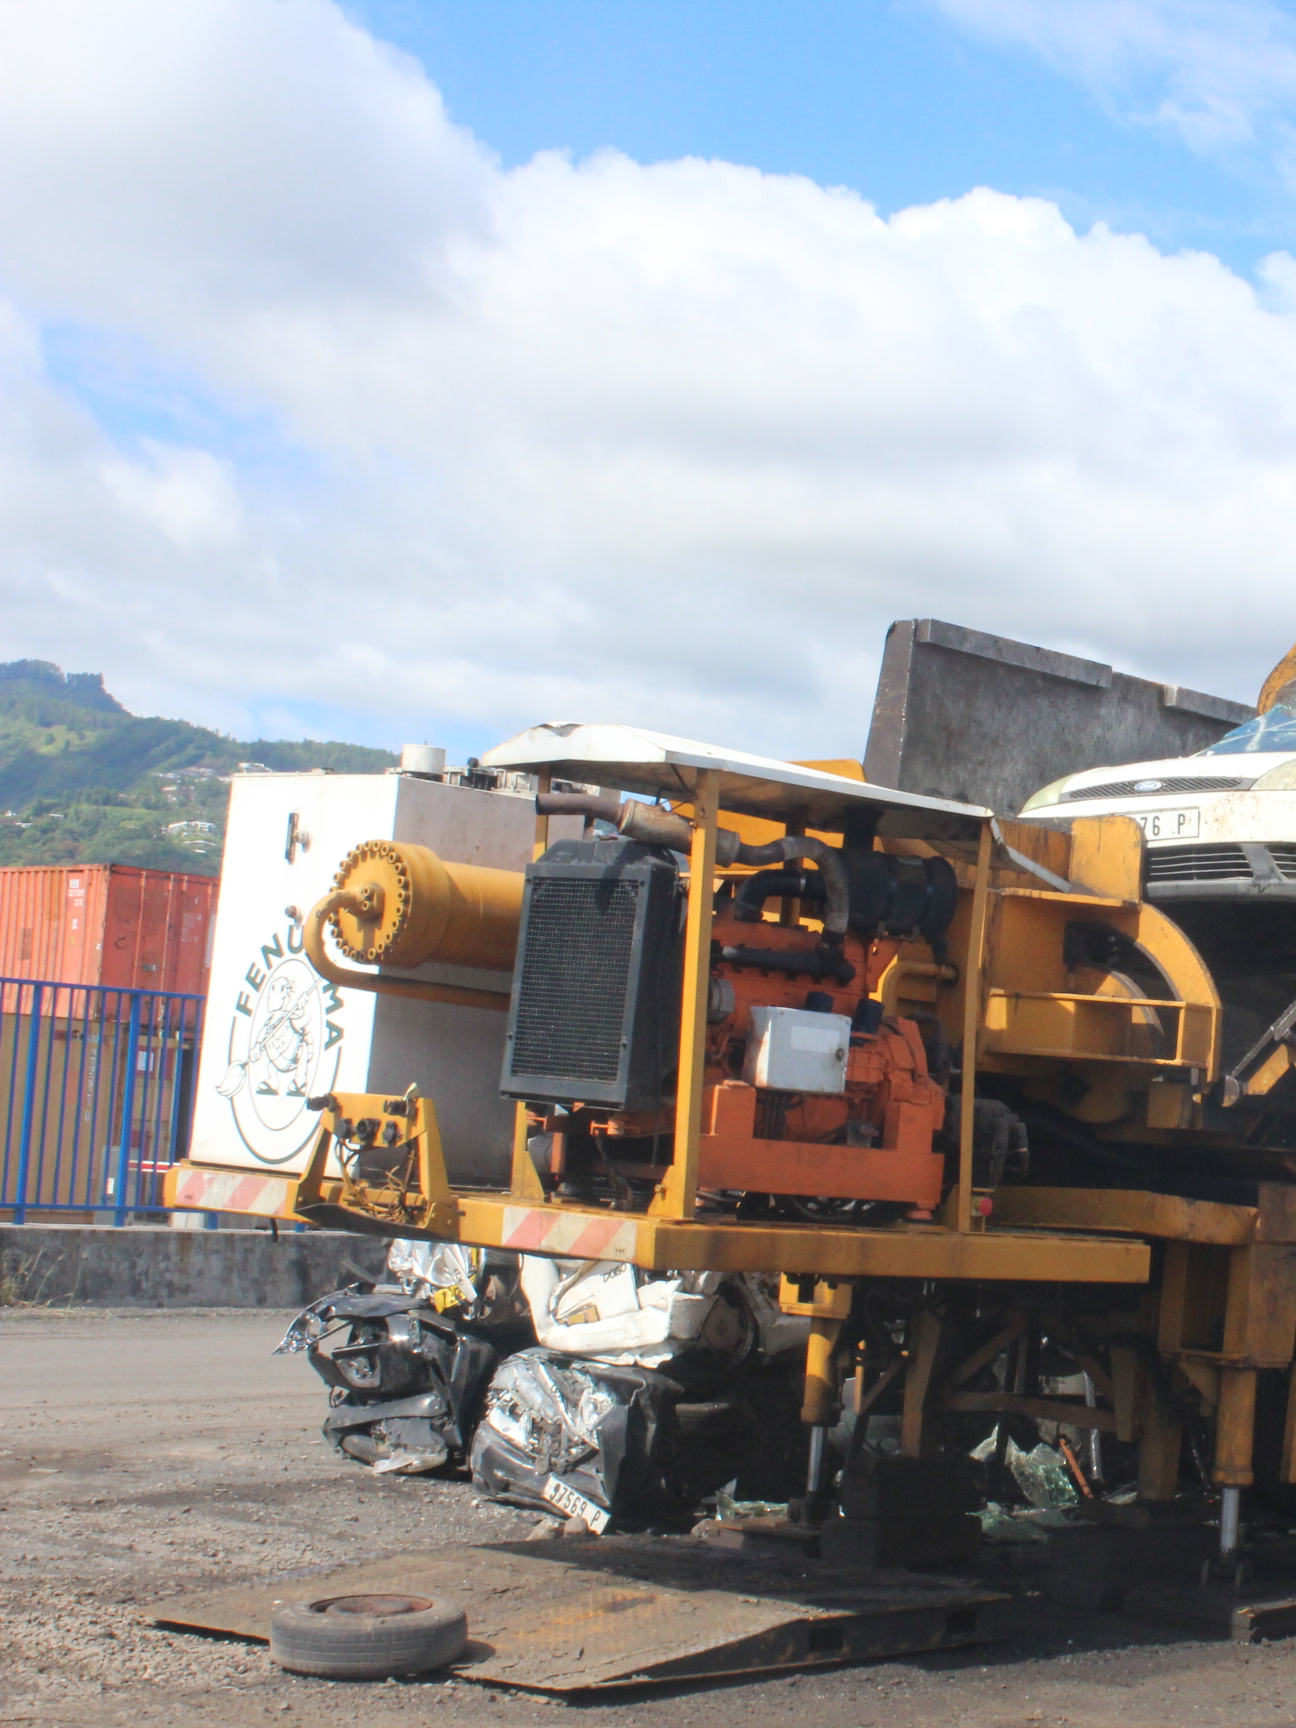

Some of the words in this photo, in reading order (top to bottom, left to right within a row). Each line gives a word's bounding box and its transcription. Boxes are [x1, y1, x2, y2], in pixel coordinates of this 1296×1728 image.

[1177, 814, 1186, 835] P
[236, 924, 304, 1017] FENU
[323, 984, 345, 1051] MA
[267, 1024, 291, 1051] FENUA
[590, 1510, 601, 1527] P
